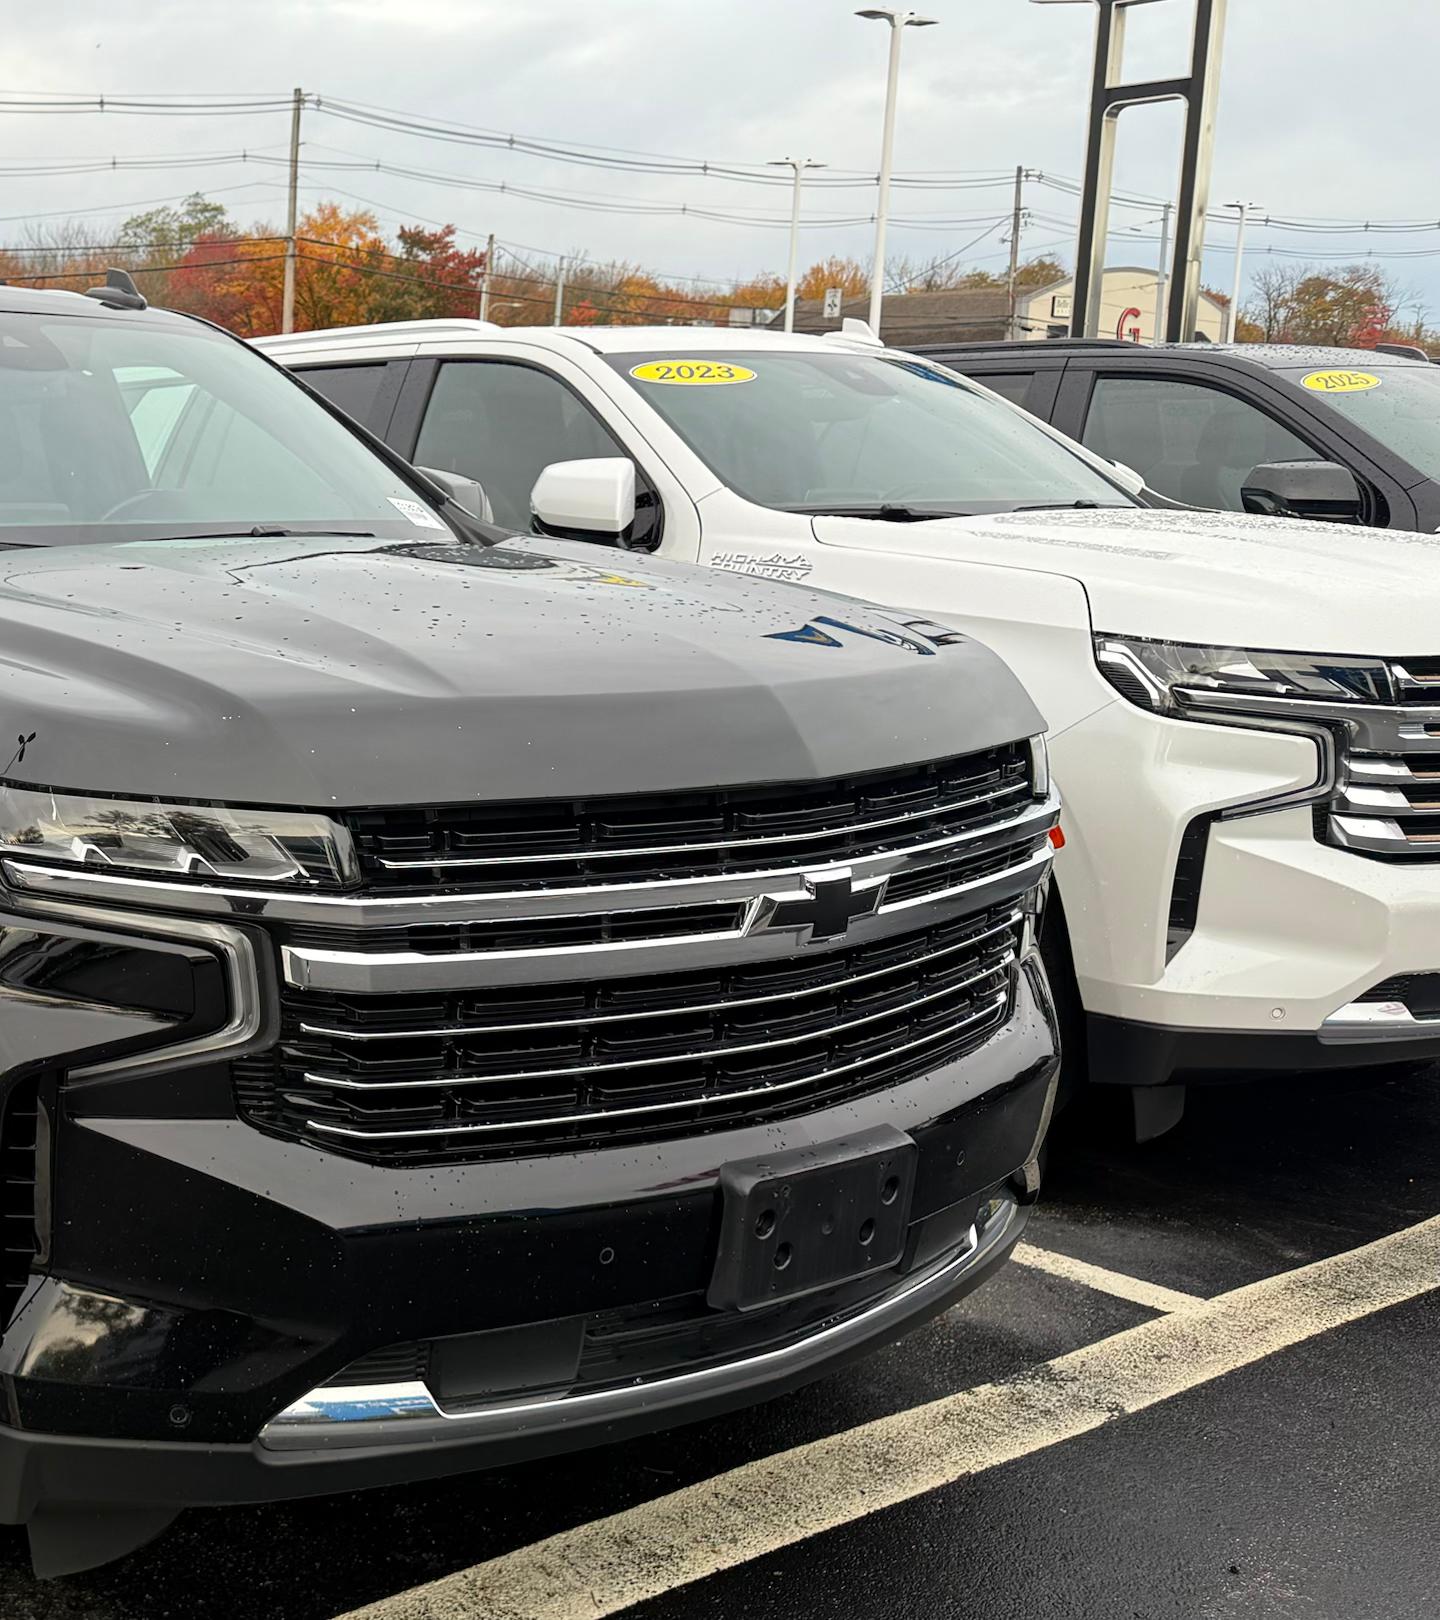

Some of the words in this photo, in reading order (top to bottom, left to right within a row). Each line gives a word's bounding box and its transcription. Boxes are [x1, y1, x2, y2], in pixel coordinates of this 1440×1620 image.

[655, 365, 735, 380] 2023
[1315, 373, 1370, 389] 2025
[711, 551, 764, 566] HIGH
